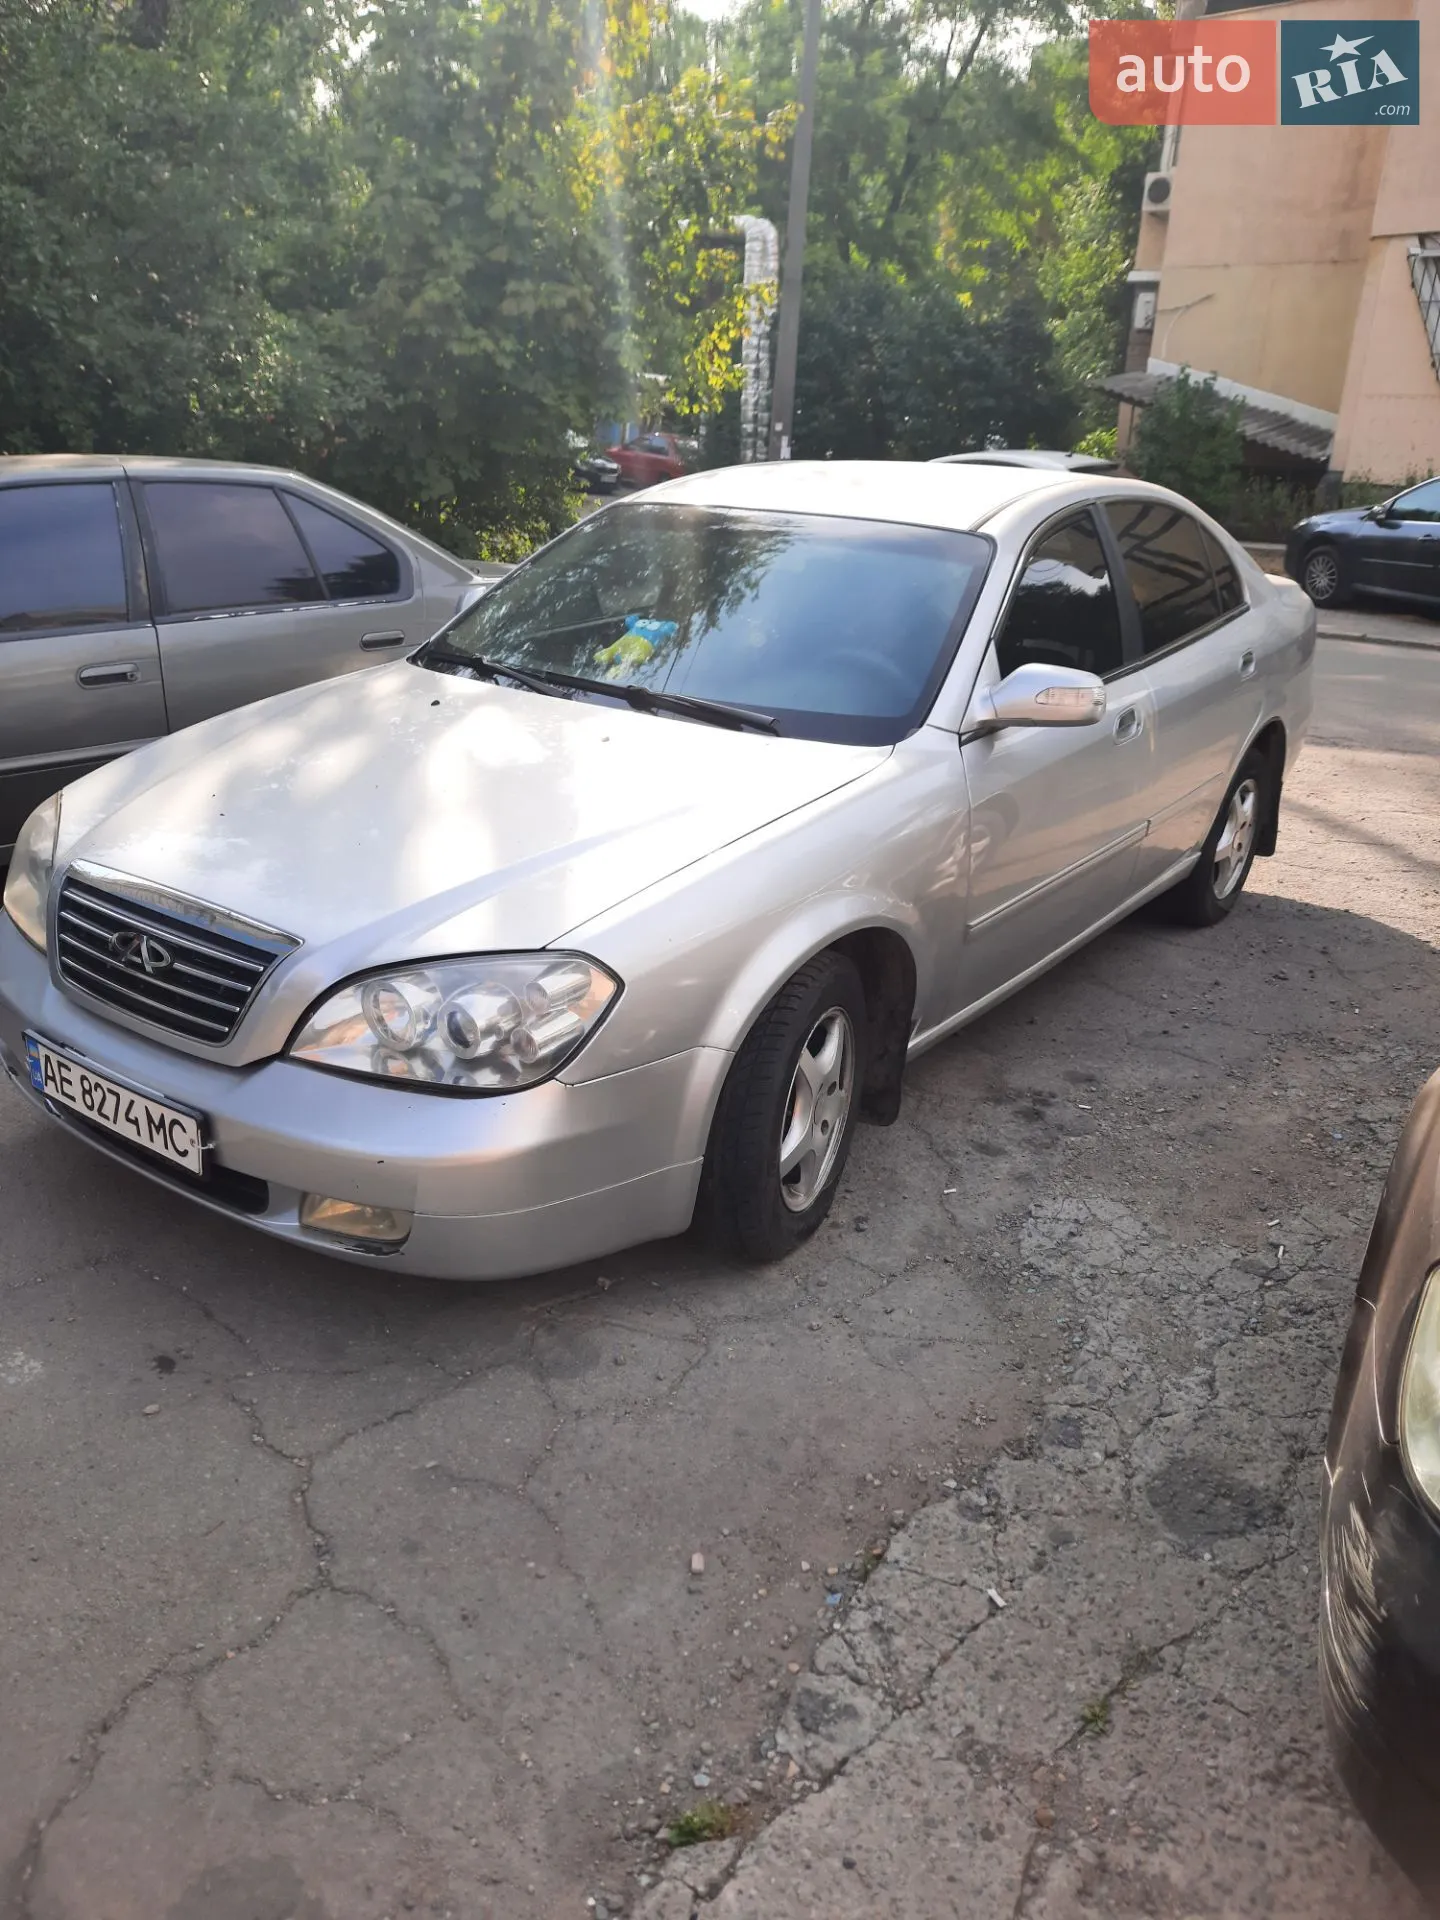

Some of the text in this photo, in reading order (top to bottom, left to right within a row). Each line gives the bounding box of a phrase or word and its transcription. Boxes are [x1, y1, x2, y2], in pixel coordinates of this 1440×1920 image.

[44, 1054, 189, 1158] AE 8274 MC
